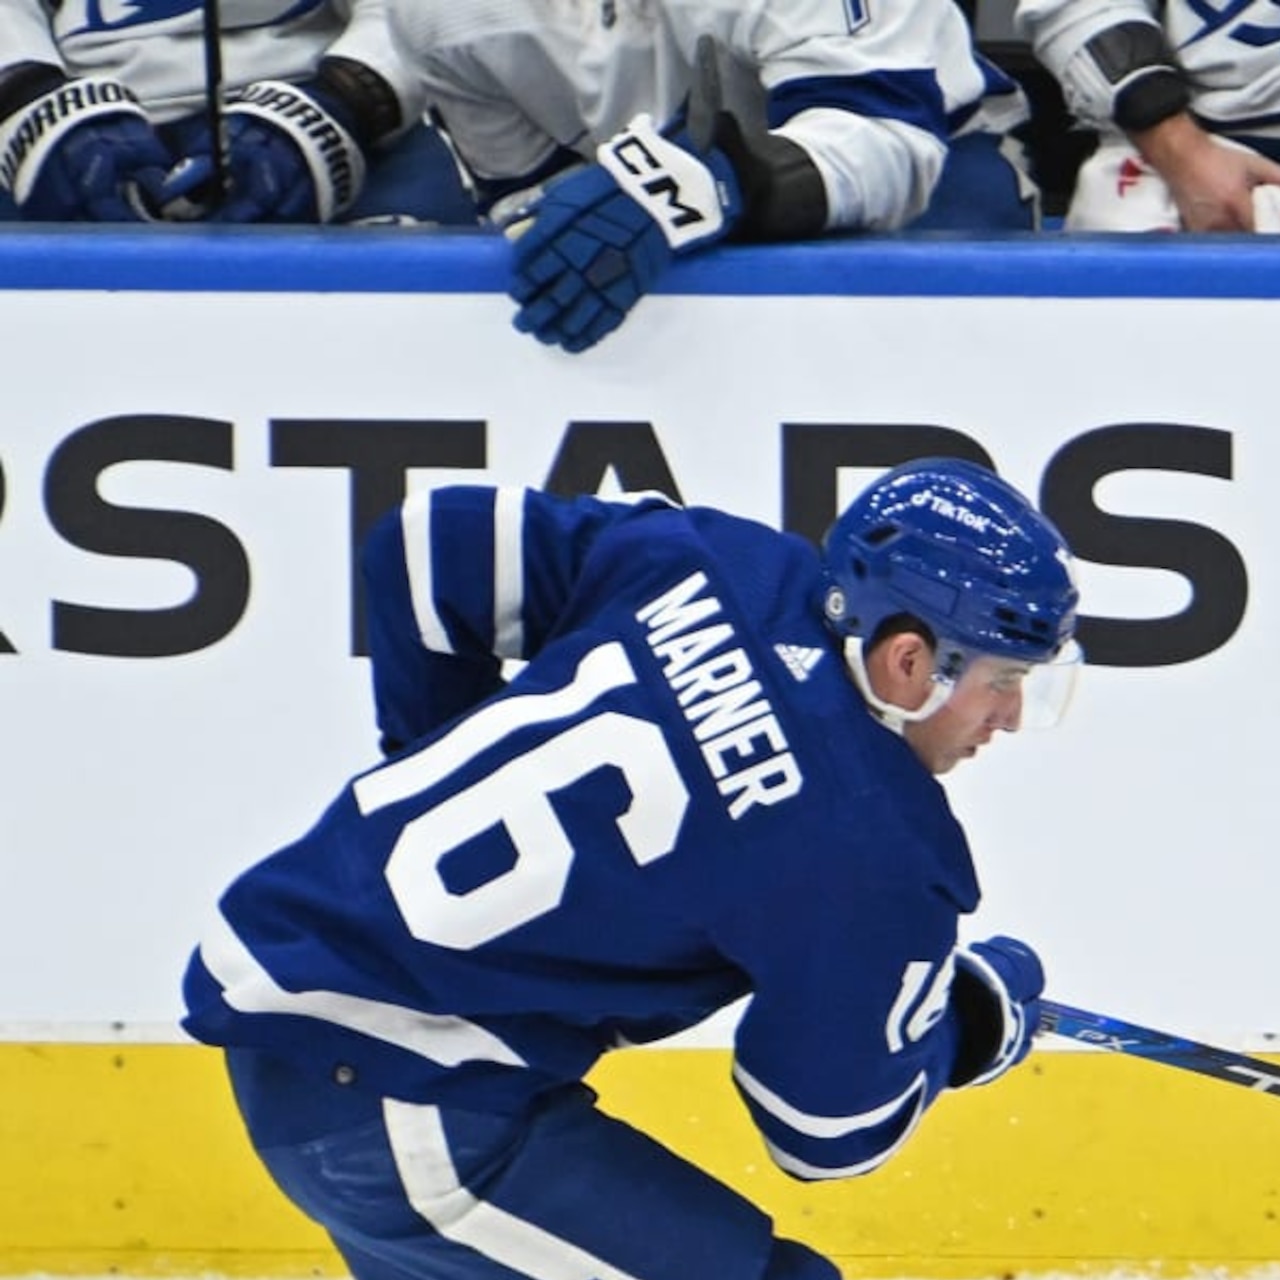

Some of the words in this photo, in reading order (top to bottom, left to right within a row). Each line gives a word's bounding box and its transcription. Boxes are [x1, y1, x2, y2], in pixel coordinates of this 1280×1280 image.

[929, 495, 992, 534] TikTok
[635, 570, 804, 821] MARNER
[353, 640, 691, 950] 16
[886, 960, 956, 1053] 16
